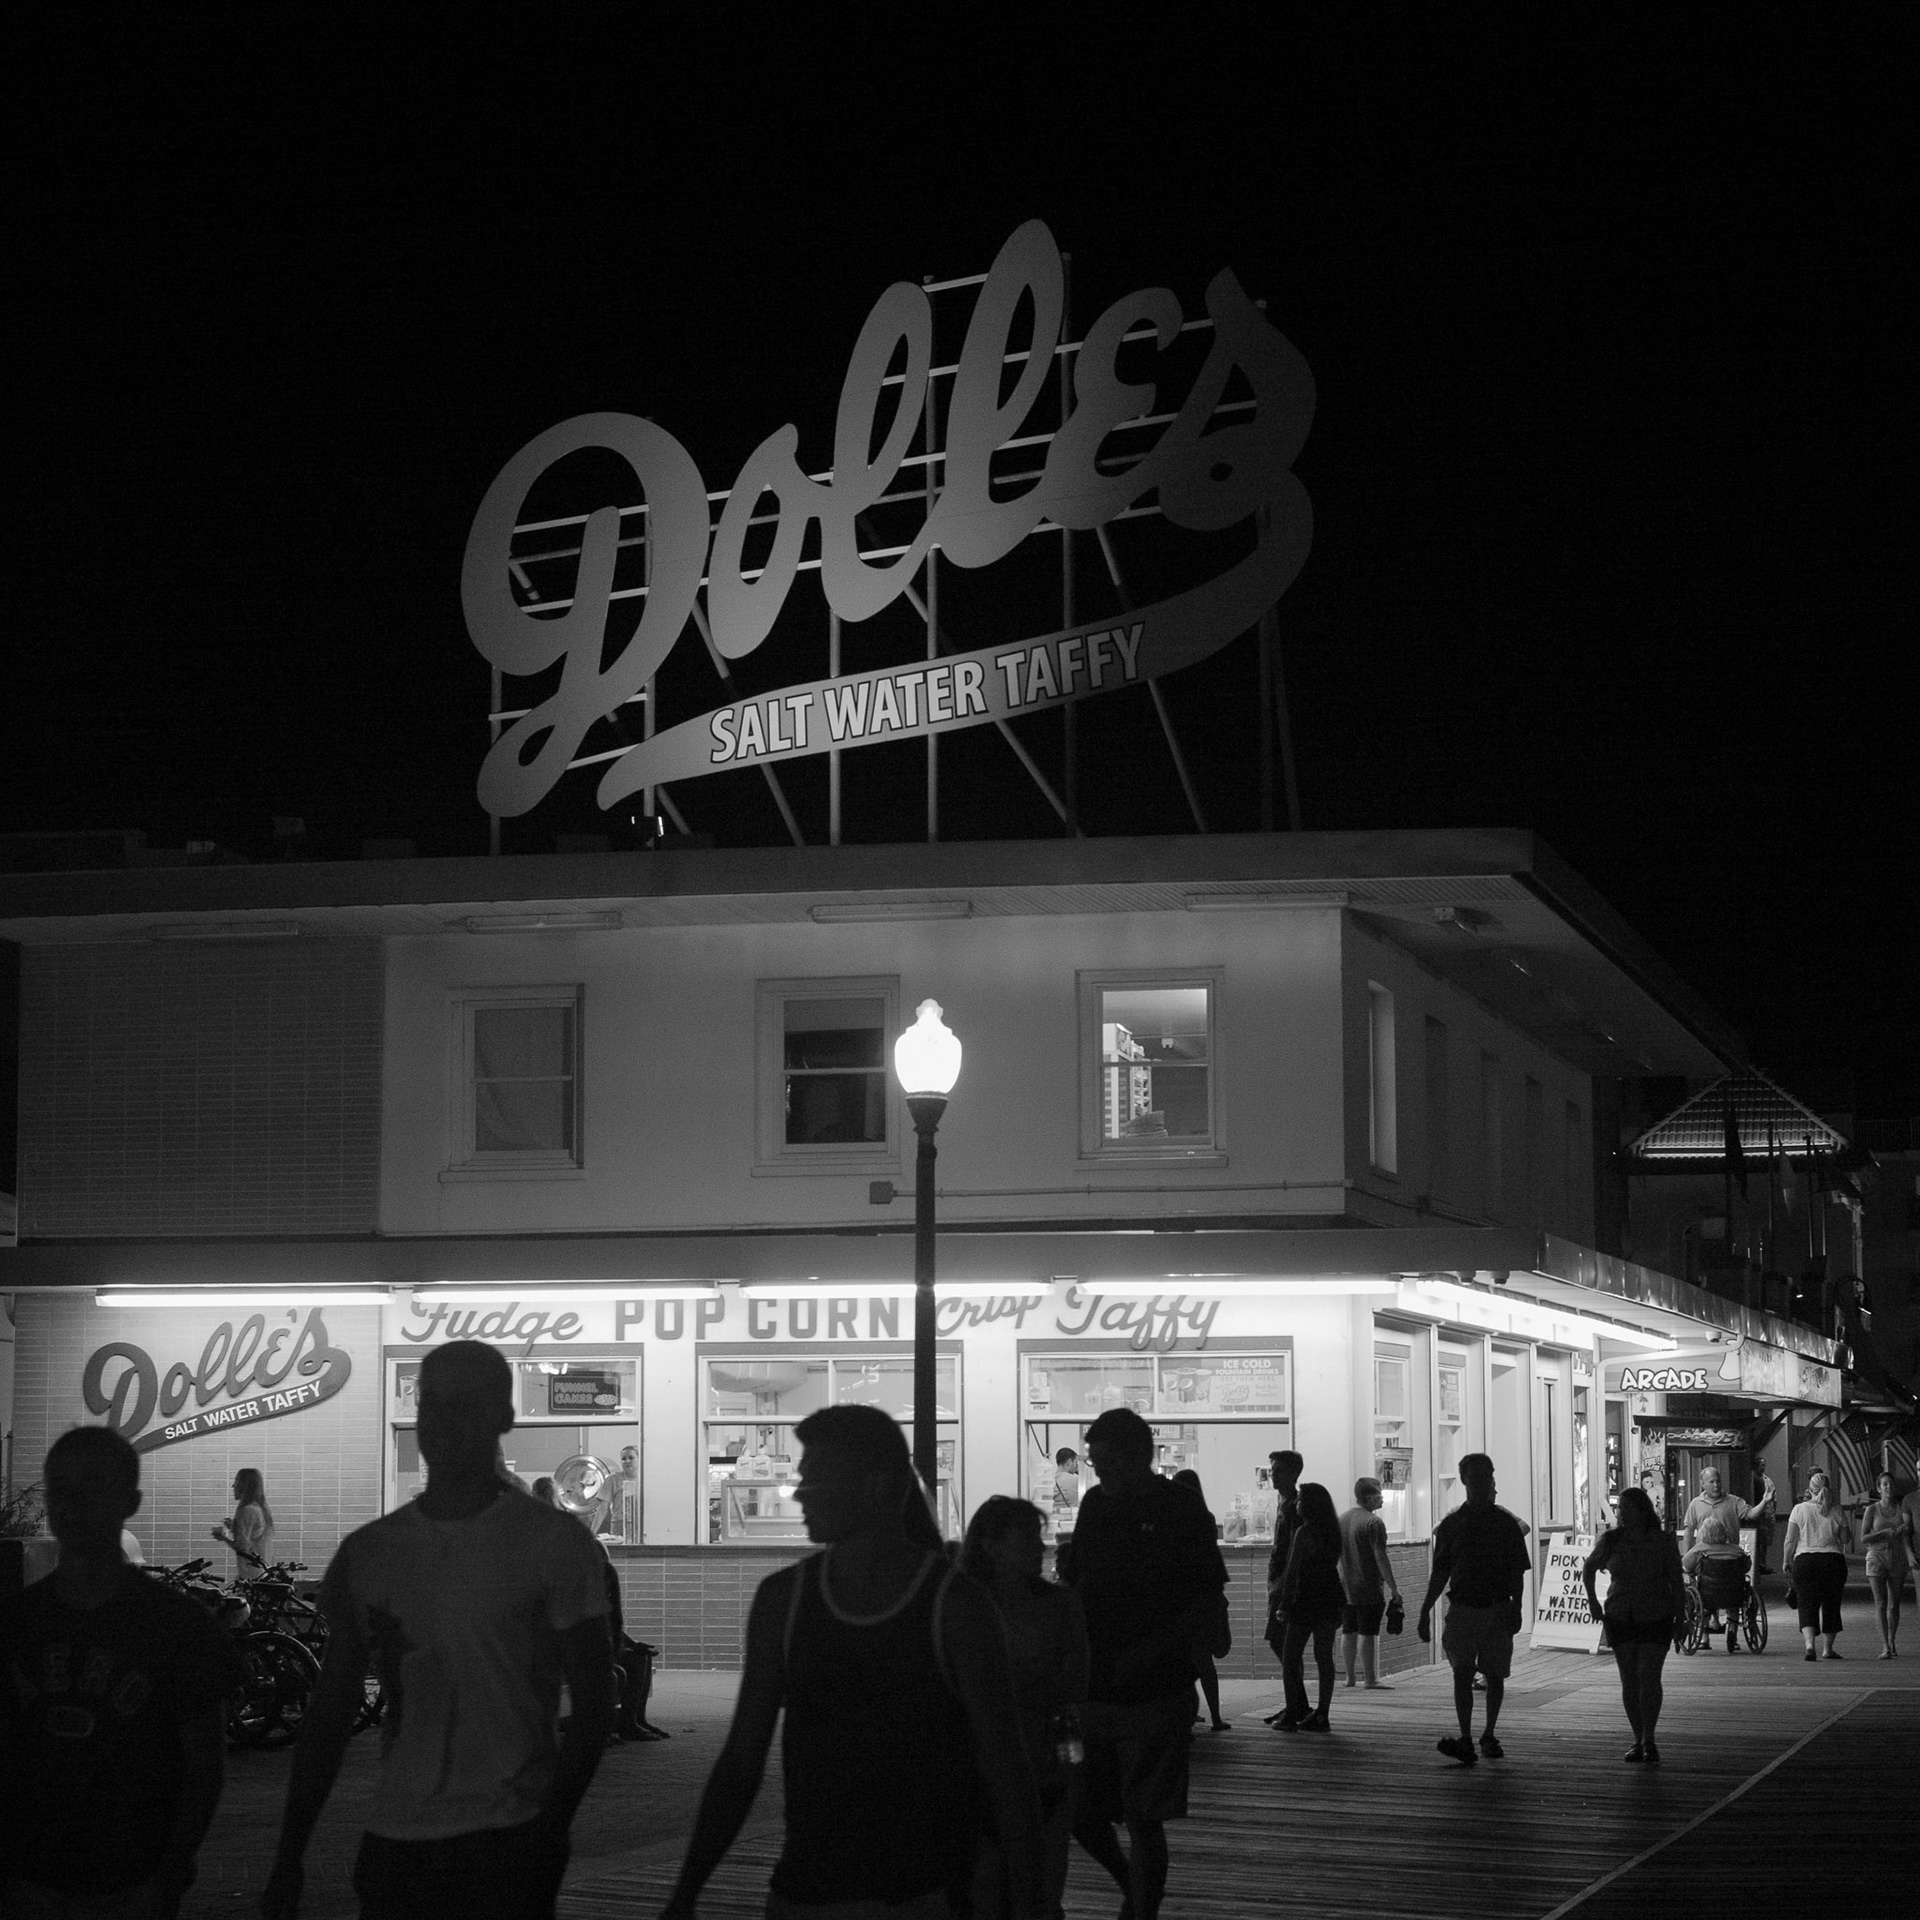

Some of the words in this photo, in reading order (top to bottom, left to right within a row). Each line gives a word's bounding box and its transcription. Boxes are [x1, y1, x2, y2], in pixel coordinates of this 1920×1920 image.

[710, 692, 812, 764] SALT
[822, 660, 987, 744] WATER
[994, 622, 1146, 709] TAFFY
[935, 1295, 1043, 1337] Crisp
[1056, 1285, 1220, 1351] Taffy
[401, 1300, 583, 1357] Fudge
[1223, 1359, 1239, 1368] ICE
[1242, 1359, 1271, 1368] COLD
[1620, 1367, 1709, 1391] ARCADE
[554, 1382, 598, 1393] FUNNEL
[554, 1393, 593, 1404] CAKES
[165, 1419, 198, 1440] SALT
[203, 1400, 260, 1428] WATER
[262, 1380, 322, 1413] TAFFY
[1550, 1554, 1579, 1567] PICK
[1562, 1569, 1583, 1582] OW
[1562, 1584, 1585, 1595] SAL
[1549, 1596, 1589, 1610] WATER
